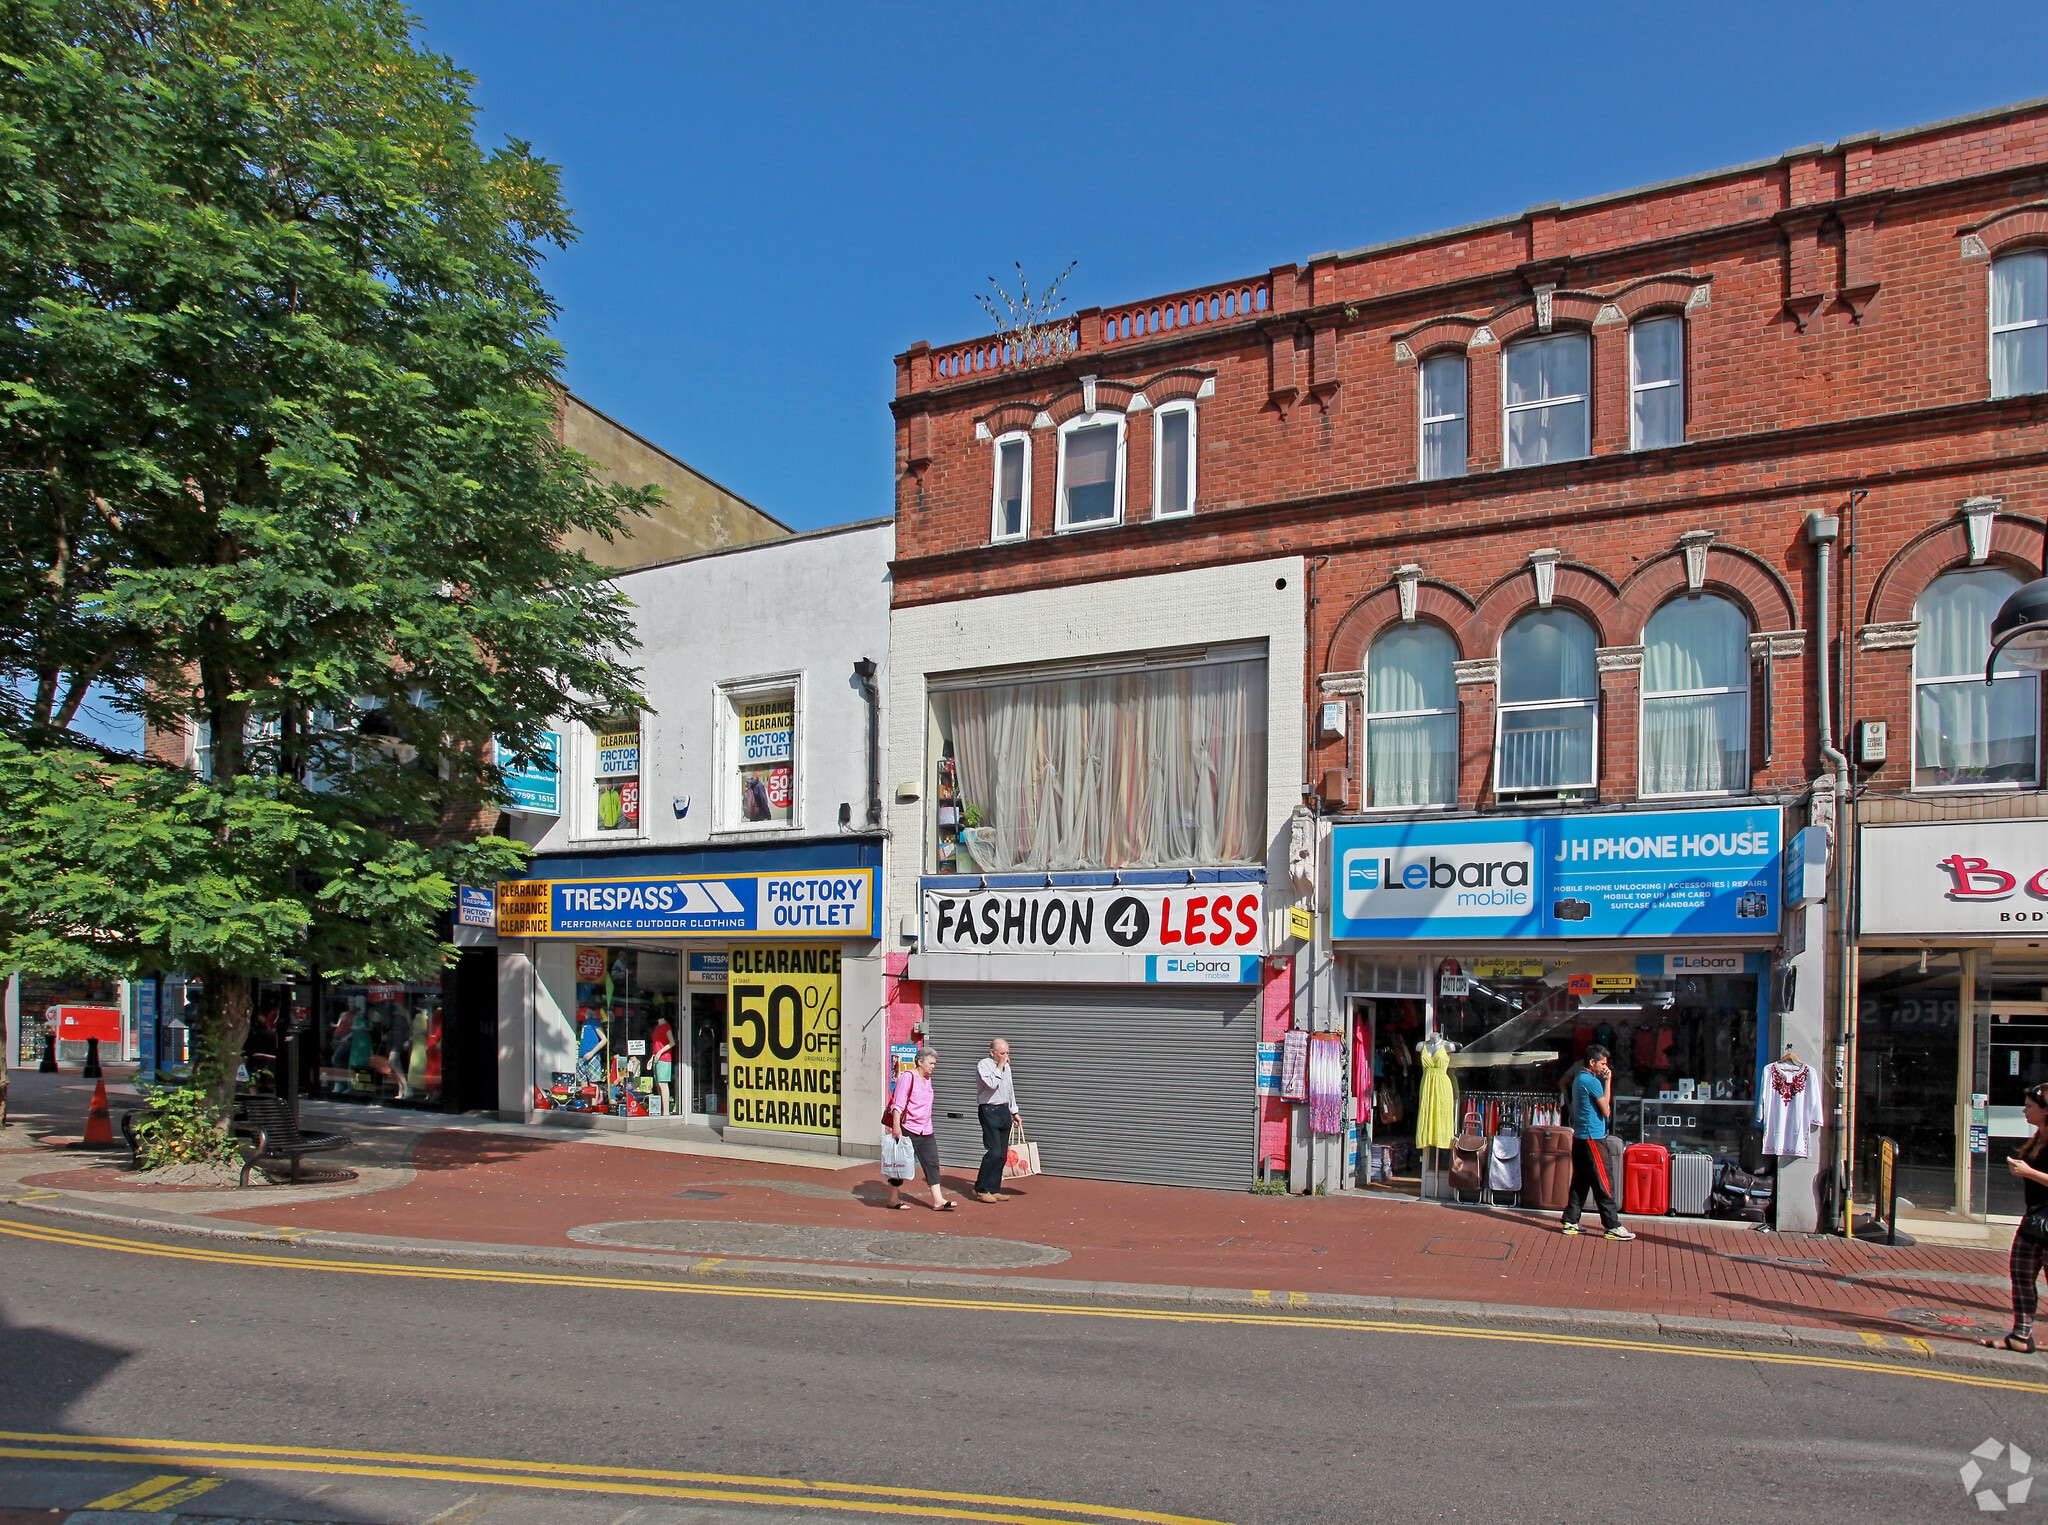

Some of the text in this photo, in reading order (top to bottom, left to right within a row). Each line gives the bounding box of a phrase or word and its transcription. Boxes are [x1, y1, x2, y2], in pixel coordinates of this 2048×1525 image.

[745, 731, 793, 747] FACTORY
[748, 744, 790, 759] OUTLET
[517, 792, 536, 800] 7895
[539, 794, 555, 803] 1515
[1554, 832, 1769, 862] J H PHONE HOUSE
[1384, 856, 1529, 890] Lebara
[500, 884, 548, 897] CLEARANCE
[768, 878, 863, 902] FACTORY
[1668, 881, 1725, 889] ACCESSORIES
[1732, 880, 1768, 888] REPAIRS
[463, 898, 491, 907] TRESPASS
[1458, 889, 1527, 906] mobile
[462, 908, 492, 917] FACTORY
[500, 902, 548, 915] CLEARANCE
[1611, 902, 1650, 910] SUITCASE
[464, 914, 490, 923] OUTLET
[774, 904, 855, 926] OUTLET
[937, 894, 1258, 947] FASHION 4 LESS
[2000, 912, 2048, 922] BOD
[500, 920, 548, 932] CLEARANCE
[561, 919, 745, 928] PERFORMANCE OUTDOOR CLOTHING
[579, 955, 603, 967] 50%
[733, 950, 841, 974] CLEARANCE
[1180, 960, 1230, 972] Lebara
[1685, 956, 1736, 968] Lebara
[579, 966, 603, 975] OFF
[1572, 978, 1590, 988] Ria
[1524, 991, 1578, 1015] SALE
[732, 984, 840, 1061] 50%
[804, 1032, 840, 1054] OFF
[896, 1045, 917, 1053] Lebara
[734, 1066, 841, 1095] CLEARANCE
[734, 1098, 841, 1129] CLEARANCE
